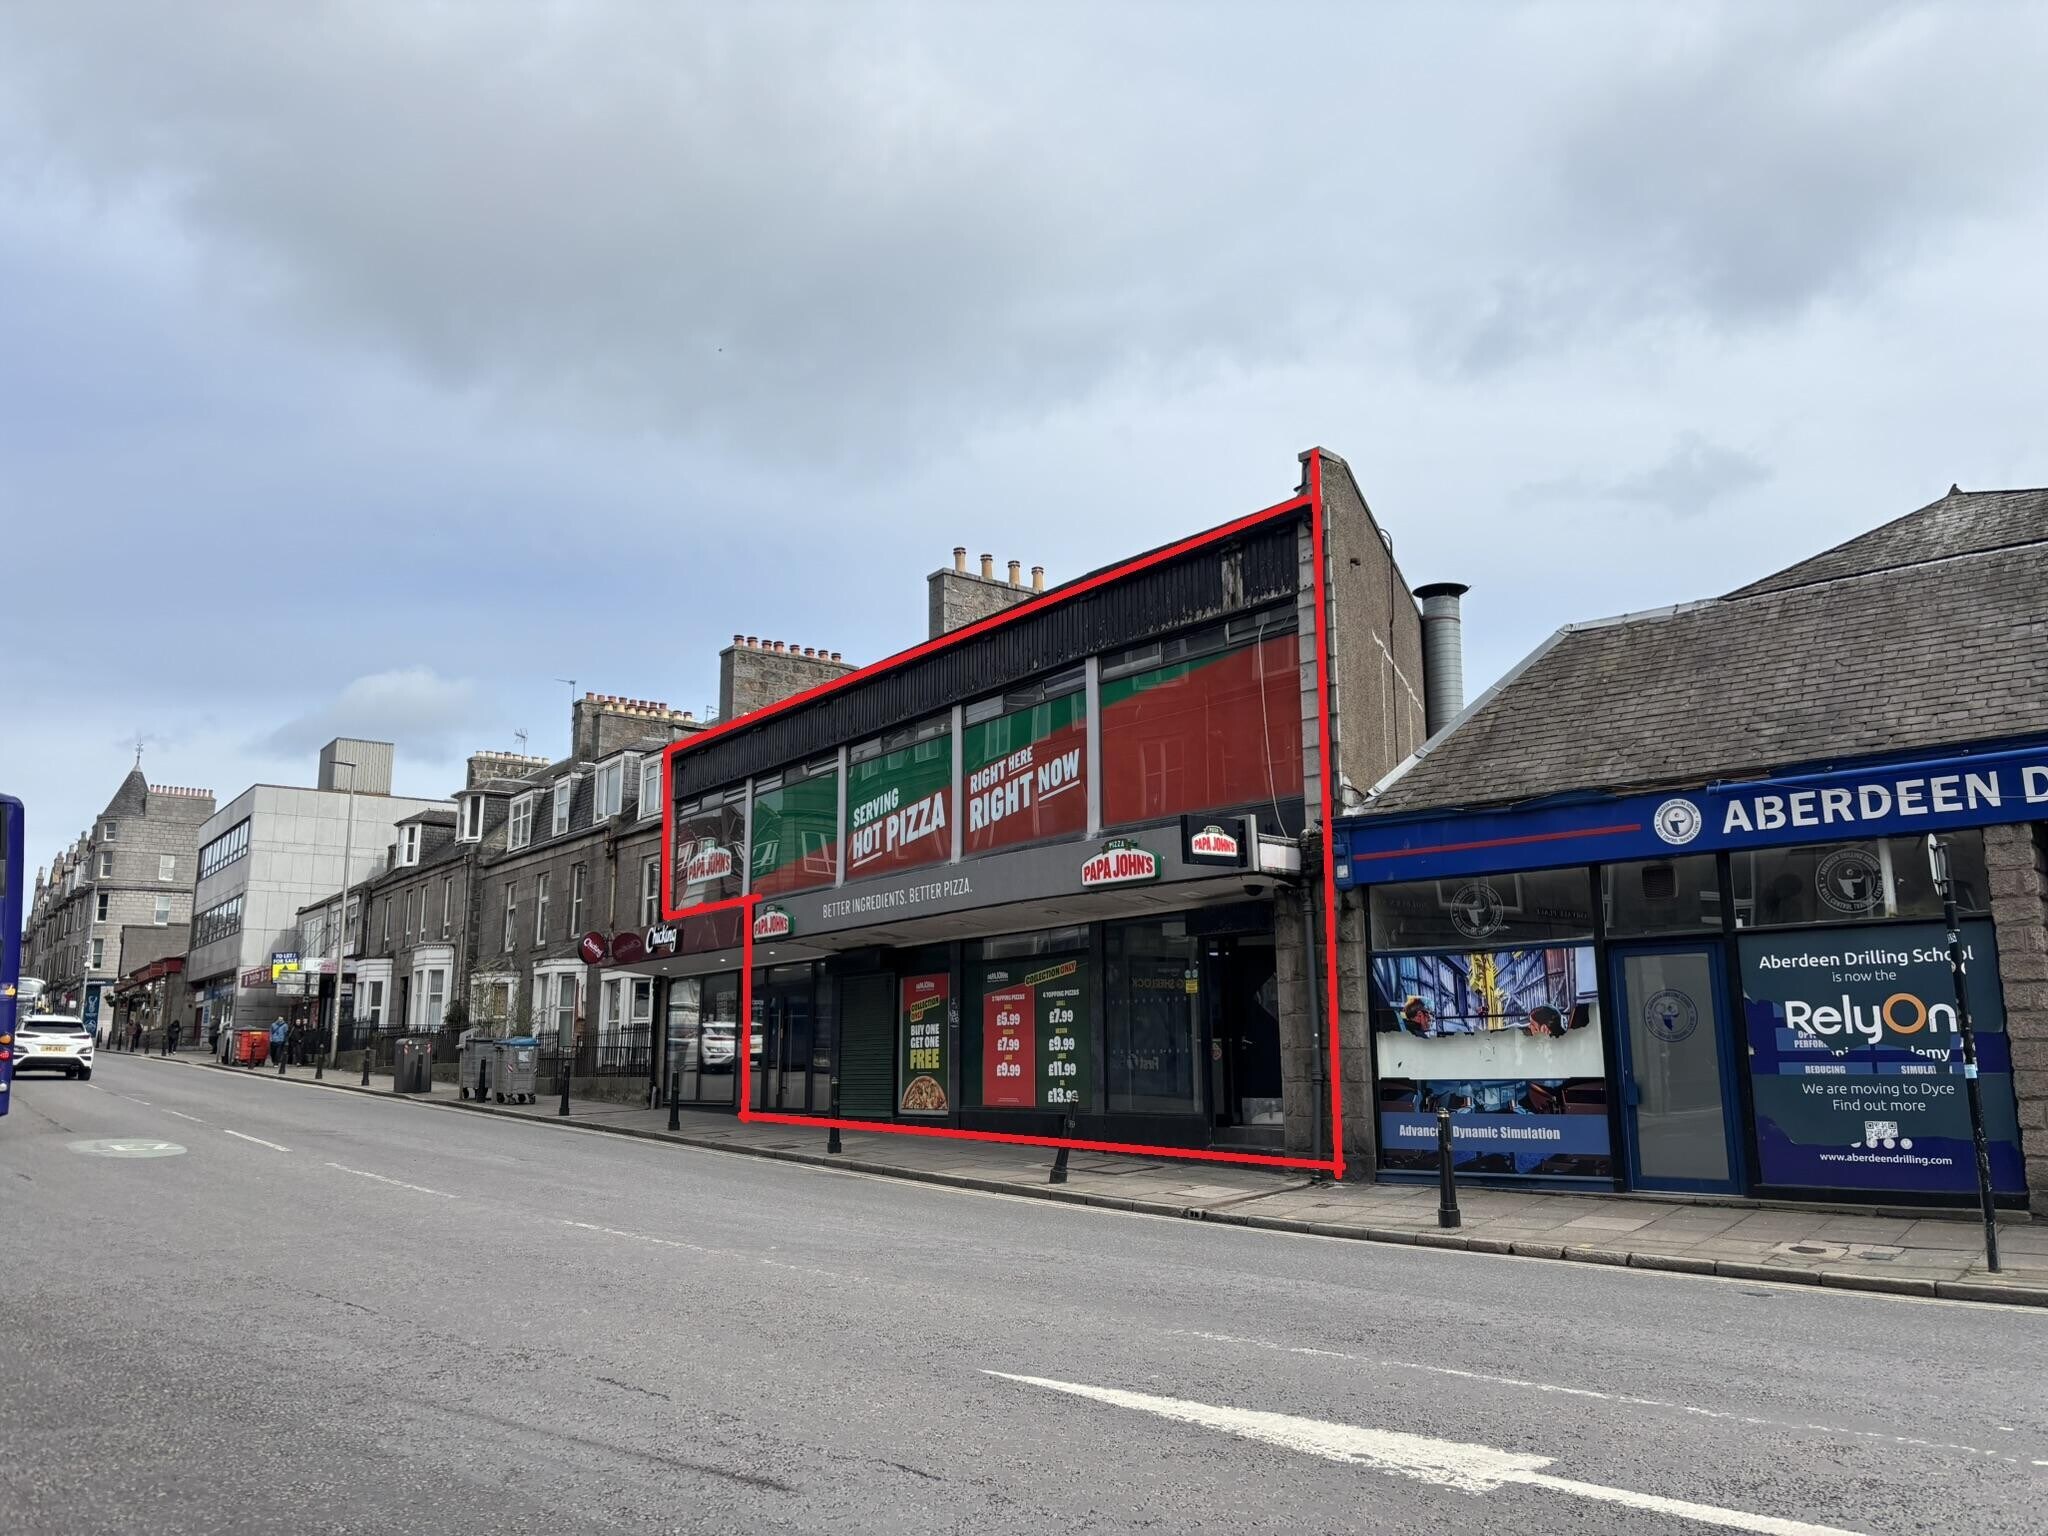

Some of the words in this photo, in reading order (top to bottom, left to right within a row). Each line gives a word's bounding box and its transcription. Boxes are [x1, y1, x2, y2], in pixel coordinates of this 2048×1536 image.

[970, 760, 1006, 795] RIGHT
[1008, 746, 1033, 772] HERE
[969, 771, 1034, 833] RIGHT
[1038, 748, 1080, 795] NOW
[853, 788, 900, 828] SERVING
[1723, 771, 2002, 834] ABERDEEN
[852, 820, 884, 862] HOT
[886, 791, 946, 852] PIZZA
[1108, 839, 1125, 849] PIZZA
[1194, 836, 1211, 852] PAPA
[1211, 836, 1236, 853] JOHN'S
[688, 856, 706, 881] PAPA
[1084, 856, 1112, 882] PAPA
[1112, 854, 1154, 879] JOHN'S
[822, 900, 851, 919] BETTER
[852, 890, 908, 914] INGREDIENTS.
[909, 882, 942, 903] BETTER
[943, 877, 973, 898] PIZZA.
[754, 918, 769, 935] PAPA
[646, 924, 678, 953] Chicking
[1759, 953, 1840, 969] Aberdeen
[1845, 949, 1909, 967] Drilling
[1025, 967, 1060, 985] COLLECTION
[1060, 961, 1076, 974] ONLY
[1832, 971, 1842, 982] is
[1845, 972, 1872, 982] now
[1875, 969, 1897, 981] the
[996, 1011, 1020, 1026] £5.99
[1049, 1008, 1074, 1023] £7.99
[1785, 992, 1958, 1044] RelyOn
[910, 1024, 925, 1036] BUY
[925, 1023, 940, 1035] ONE
[910, 1037, 924, 1049] GET
[924, 1036, 940, 1048] ONE
[997, 1037, 1020, 1051] £7.99
[1048, 1036, 1075, 1051] £9.99
[909, 1048, 940, 1070] FREE
[996, 1062, 1020, 1076] £9.99
[1048, 1061, 1077, 1076] £11.99
[1805, 1065, 1846, 1074] REDUCING
[1802, 1083, 1824, 1094] We
[1826, 1085, 1847, 1094] are
[1850, 1083, 1900, 1098] moving
[1902, 1084, 1918, 1094] to
[1921, 1083, 1955, 1097] Dyce
[1832, 1099, 1860, 1111] Find
[1863, 1100, 1887, 1111] out
[1890, 1102, 1926, 1111] more
[1399, 1124, 1439, 1137] Advanc
[1452, 1125, 1498, 1139] Dynamic
[1500, 1126, 1561, 1140] Simulation
[1819, 1152, 1953, 1166] www.aberdeendrilling.com
